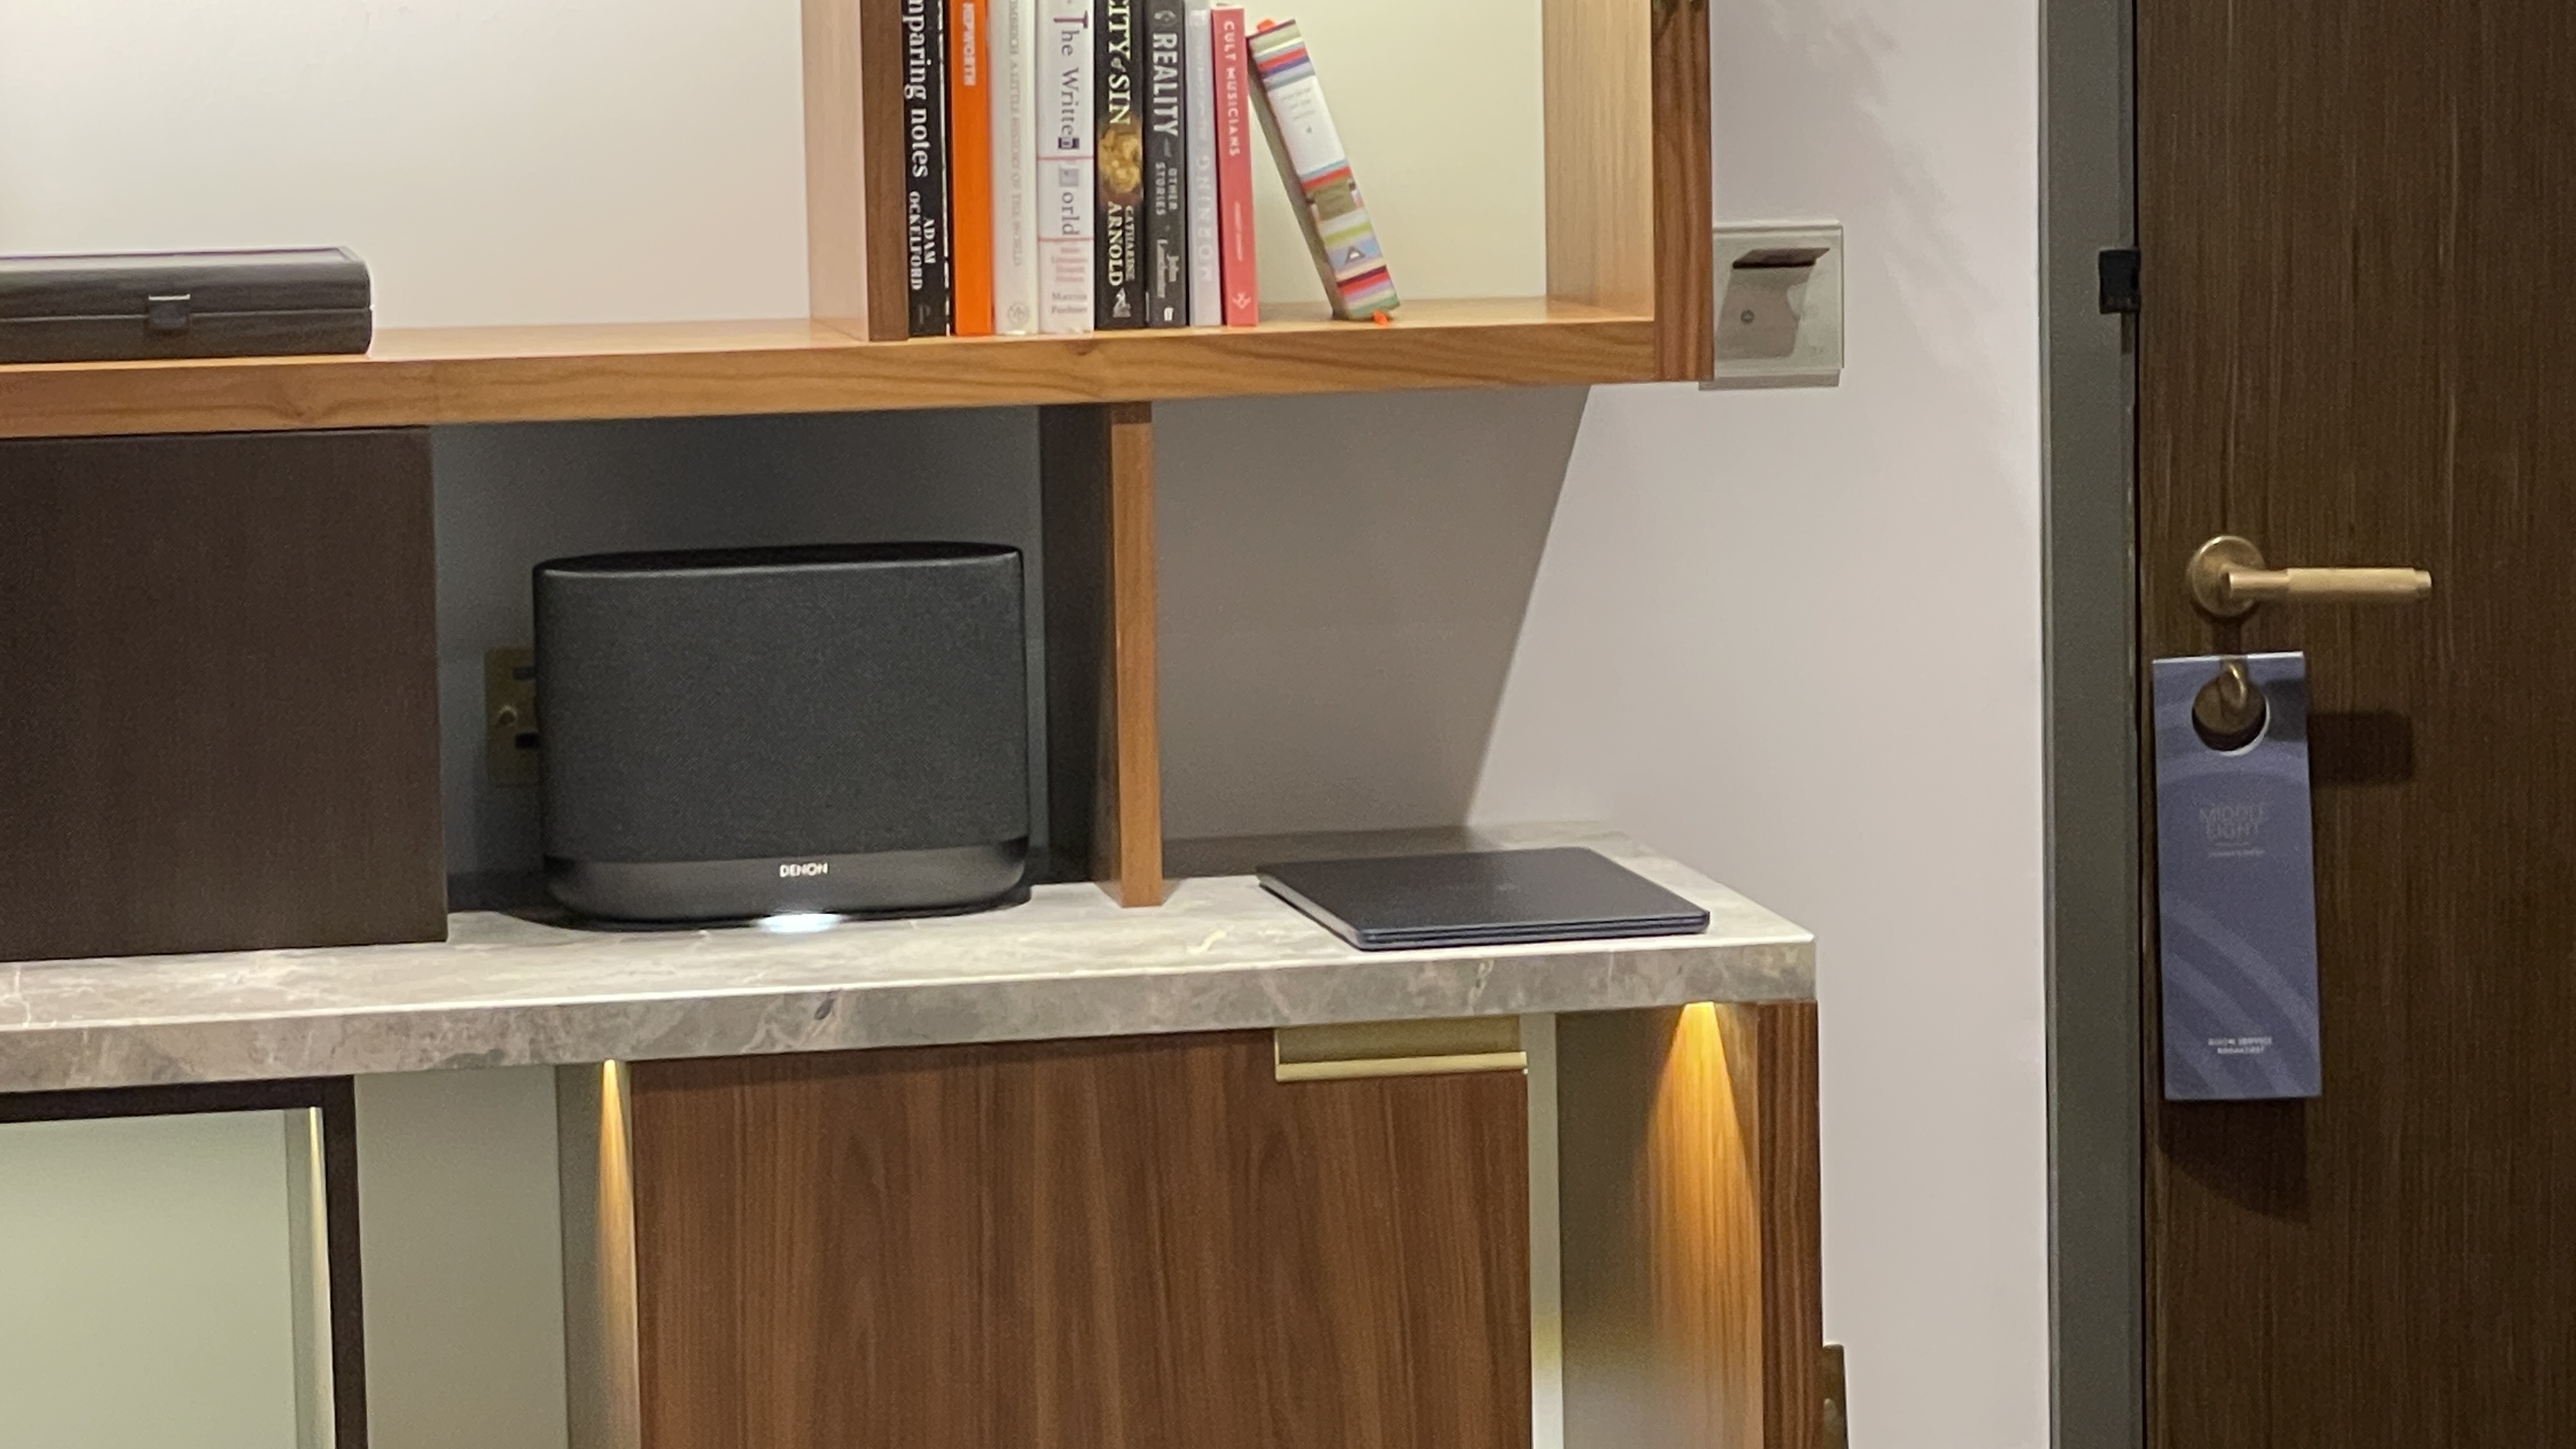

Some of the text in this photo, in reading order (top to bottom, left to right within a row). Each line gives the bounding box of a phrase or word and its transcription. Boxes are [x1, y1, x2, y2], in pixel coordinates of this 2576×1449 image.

[1054, 10, 1089, 150] The Written
[1108, 74, 1131, 125] SIN
[1153, 33, 1178, 137] REALITY
[1223, 20, 1240, 156] CULT MUSICIANS
[911, 108, 931, 177] notes
[1058, 168, 1080, 235] orld
[1155, 162, 1166, 215] STORIES
[1168, 167, 1178, 210] OTHER
[909, 191, 923, 290] OCKELFORD
[923, 218, 936, 263] ADAM
[1108, 201, 1123, 286] ARNOLD
[779, 862, 829, 878] DENON
